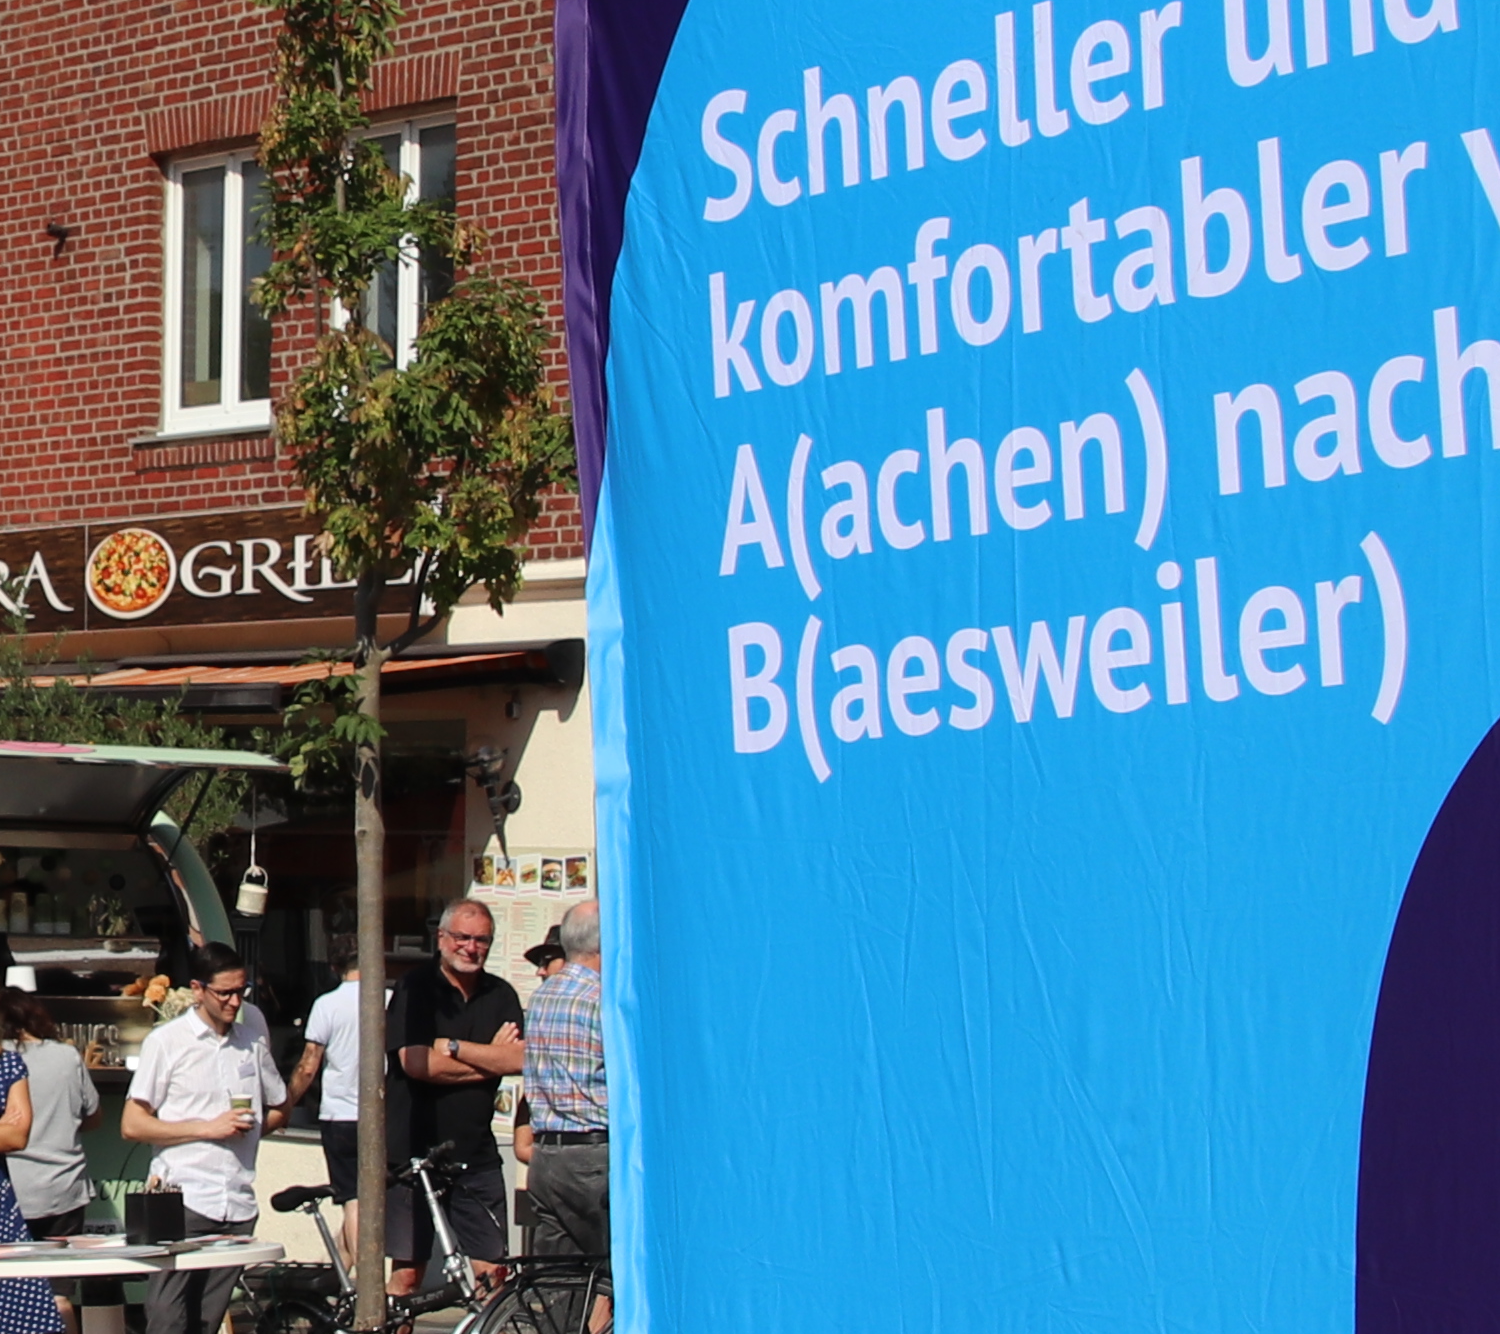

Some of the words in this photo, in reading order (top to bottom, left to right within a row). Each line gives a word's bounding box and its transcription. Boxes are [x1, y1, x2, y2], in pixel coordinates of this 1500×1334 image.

[699, 1, 1182, 223] Schneller
[708, 137, 1431, 400] komfortabler
[178, 533, 413, 603] GRIL
[718, 366, 1169, 600] A(achen)
[727, 530, 1408, 784] B(aesweiler)
